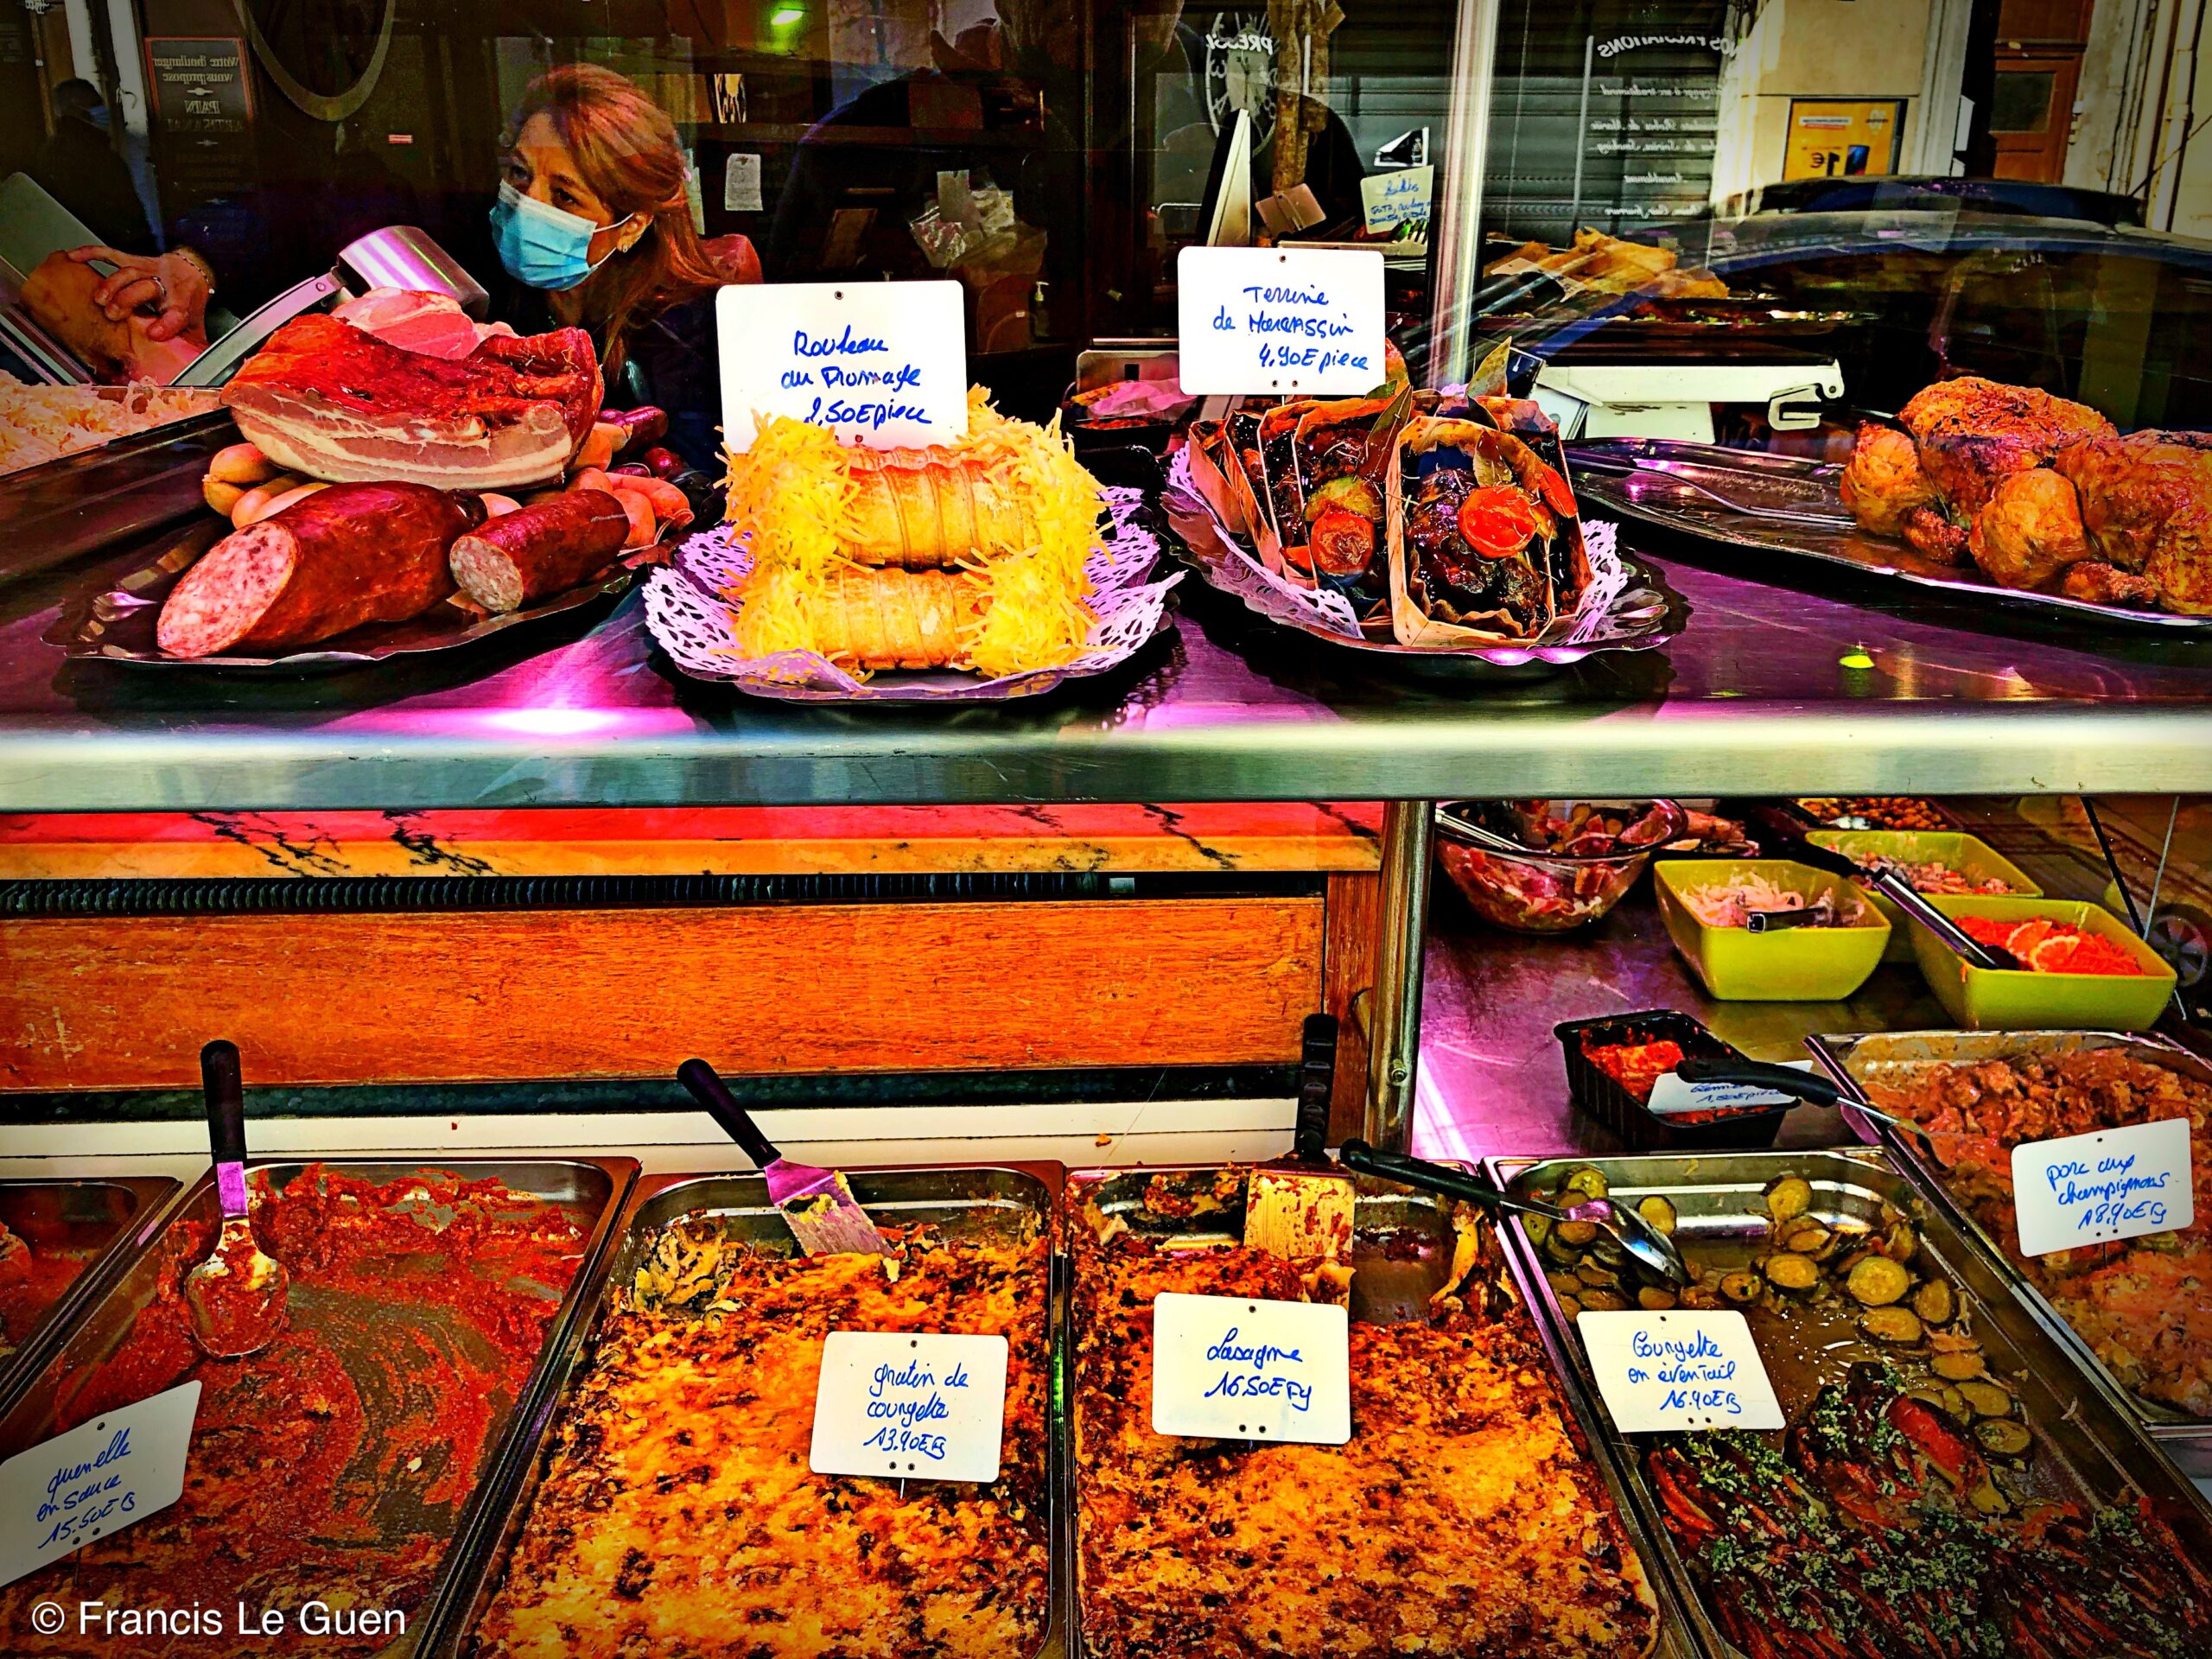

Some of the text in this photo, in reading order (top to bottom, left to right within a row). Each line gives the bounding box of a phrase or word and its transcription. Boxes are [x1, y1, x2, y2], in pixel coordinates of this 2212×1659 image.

[1243, 284, 1329, 306] Terrine
[1212, 305, 1236, 331] de
[780, 370, 814, 389] au
[2046, 1161, 2090, 1192] porc
[2057, 1172, 2171, 1205] champignons
[1207, 1327, 1303, 1370] Lasagne
[944, 1362, 969, 1388] de
[1628, 1367, 1649, 1383] en
[47, 1427, 131, 1503] quenelle
[36, 1502, 60, 1522] en
